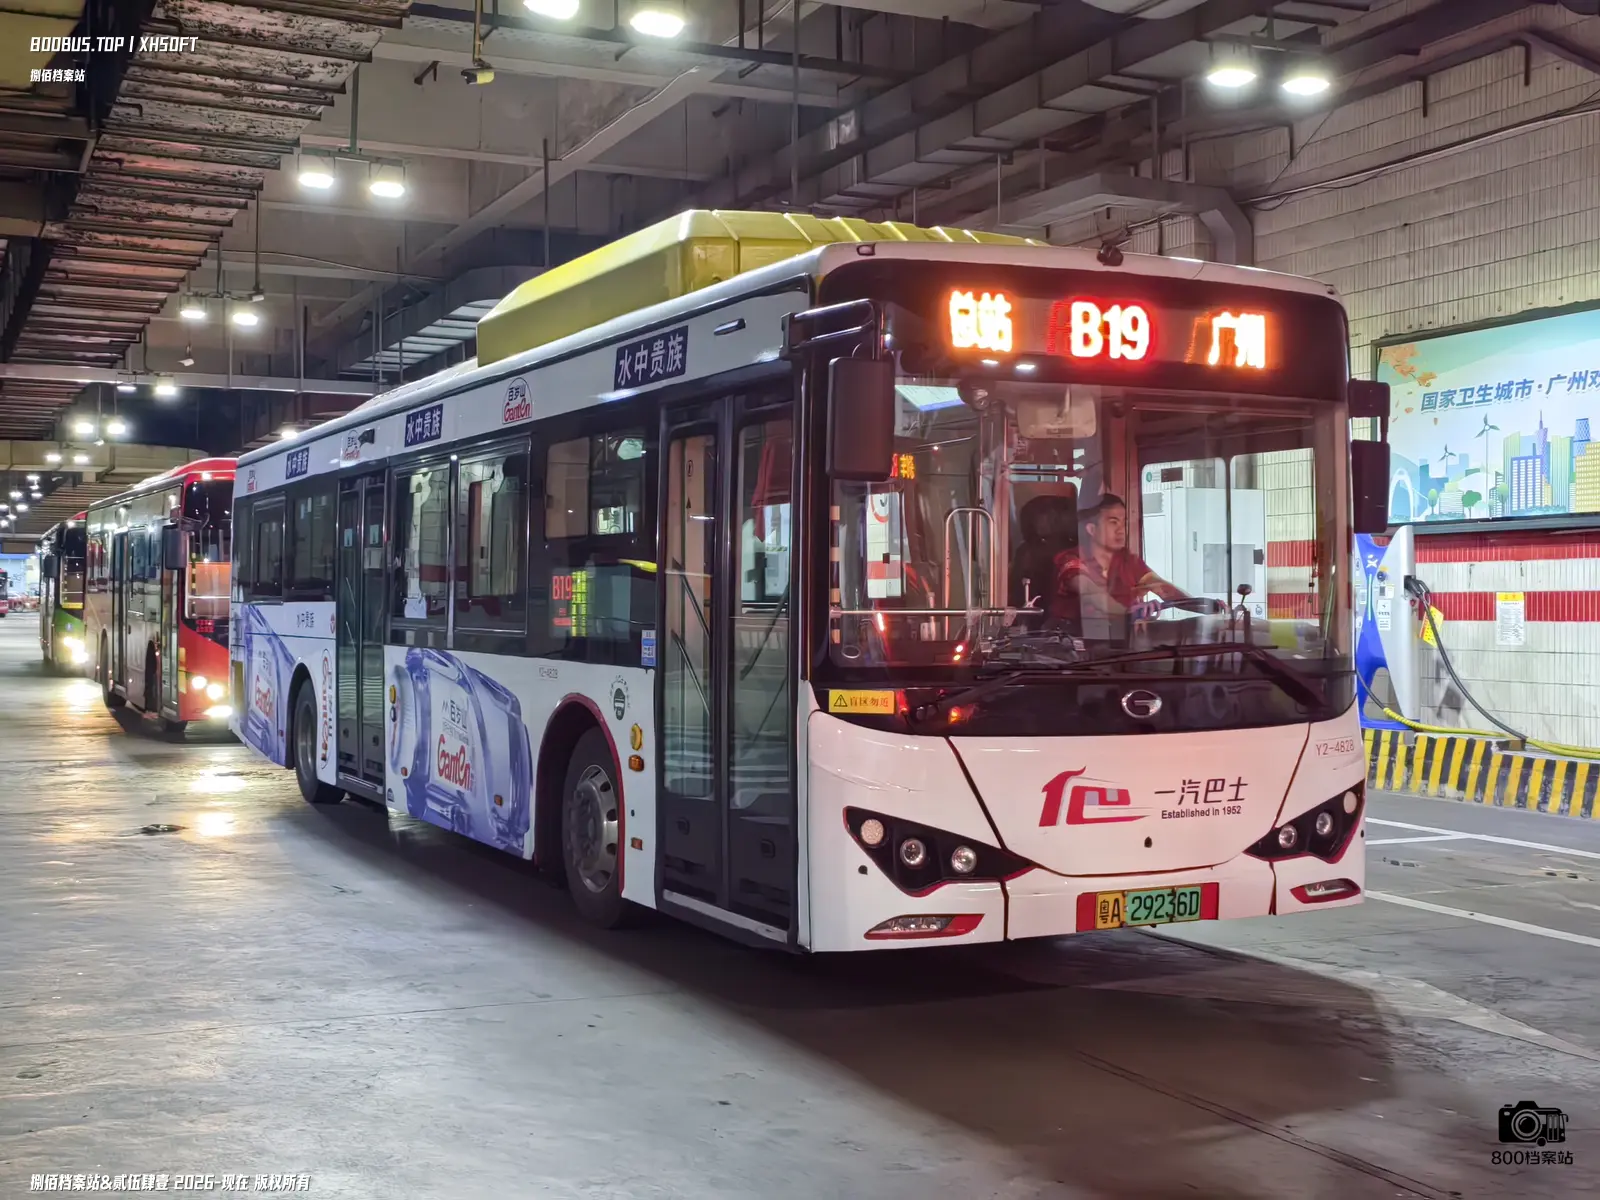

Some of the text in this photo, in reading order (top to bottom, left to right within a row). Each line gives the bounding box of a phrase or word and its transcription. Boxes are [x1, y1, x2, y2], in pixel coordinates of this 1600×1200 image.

[1070, 301, 1150, 360] B19
[617, 333, 683, 386] 水中贵族
[406, 409, 441, 443] 水中贵族
[552, 575, 572, 600] B19
[849, 696, 889, 707] 盲区勿近
[1315, 739, 1354, 756] Y2-4828
[1154, 776, 1248, 806] 一汽巴士
[1161, 805, 1242, 819] Established in 1952
[1099, 890, 1200, 924] 粤A 29236D
